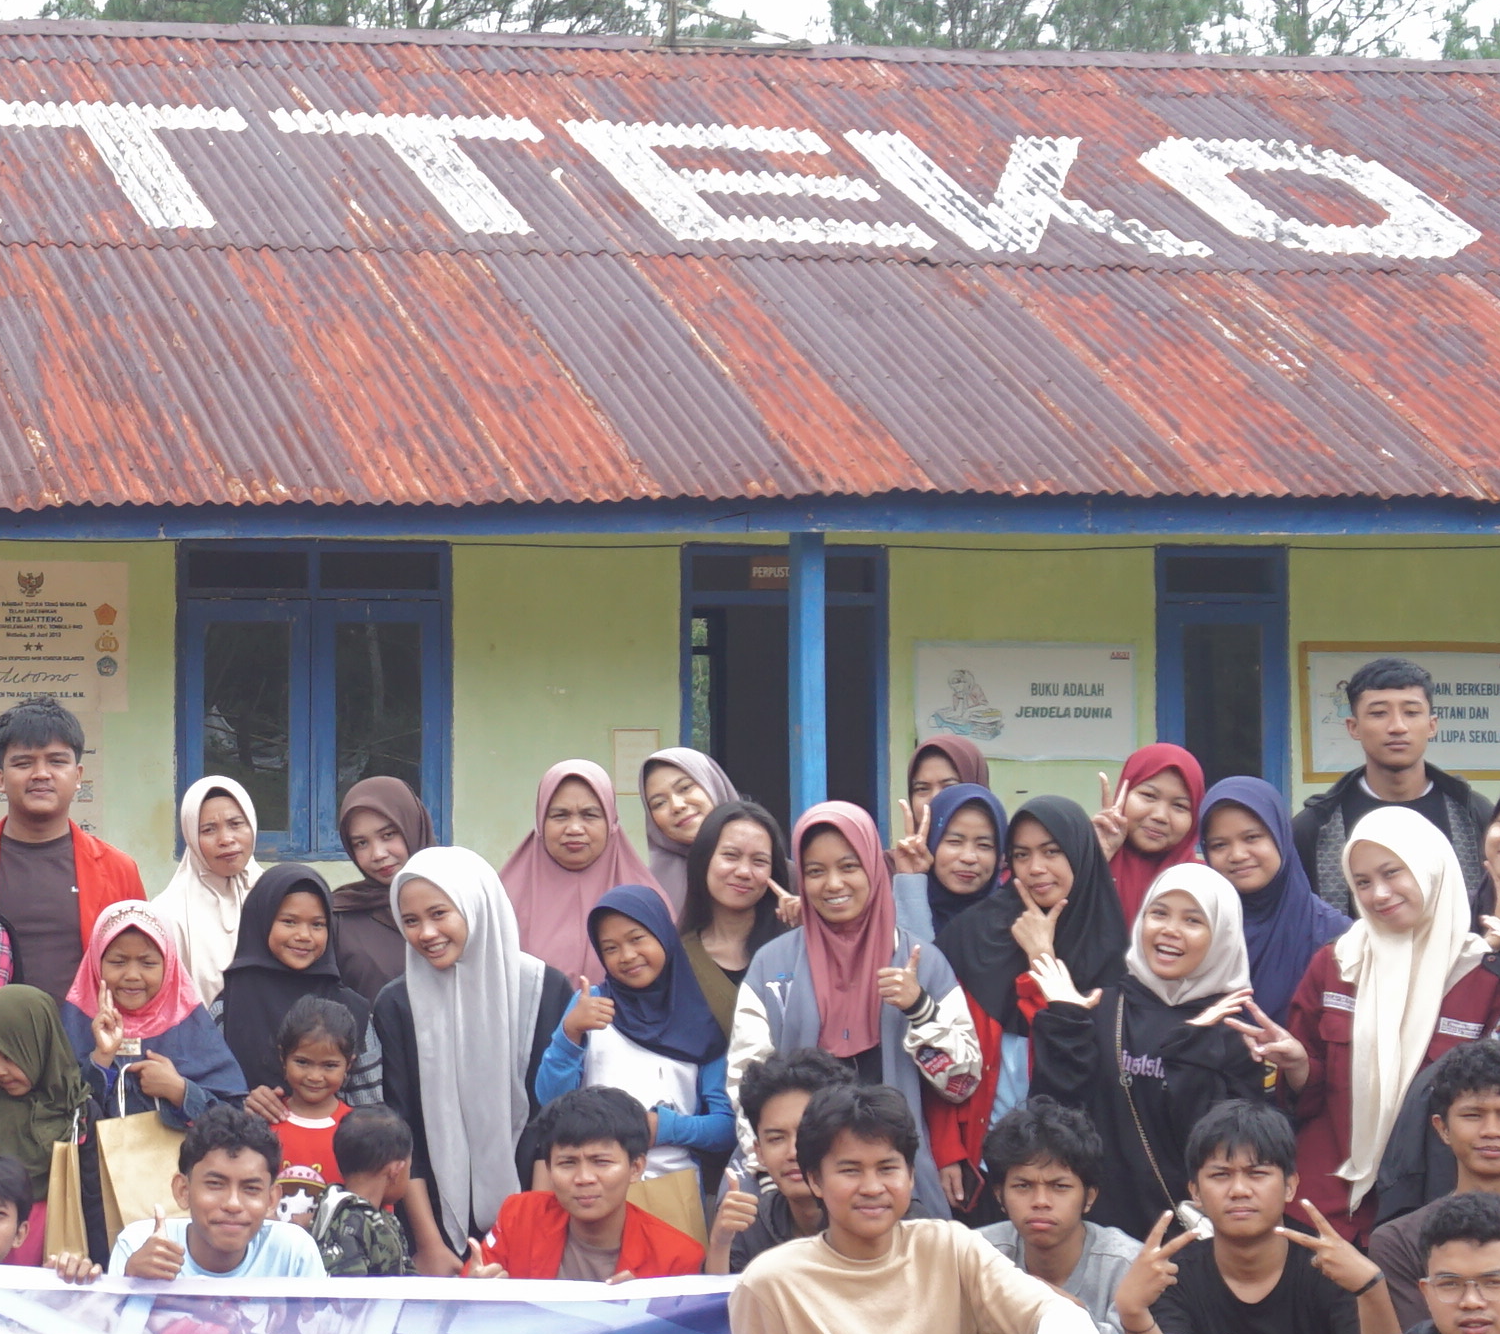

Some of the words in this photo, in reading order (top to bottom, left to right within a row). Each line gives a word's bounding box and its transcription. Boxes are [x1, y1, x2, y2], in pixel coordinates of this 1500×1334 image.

[752, 567, 790, 578] PERPUST
[1031, 683, 1060, 696] BUKU
[1062, 683, 1104, 697] ADALAH
[1432, 683, 1453, 696] AIN,
[1015, 707, 1071, 719] JENDELA
[1073, 708, 1113, 719] DUNIA
[1469, 708, 1489, 720] DAN
[1441, 731, 1466, 744] LUPA
